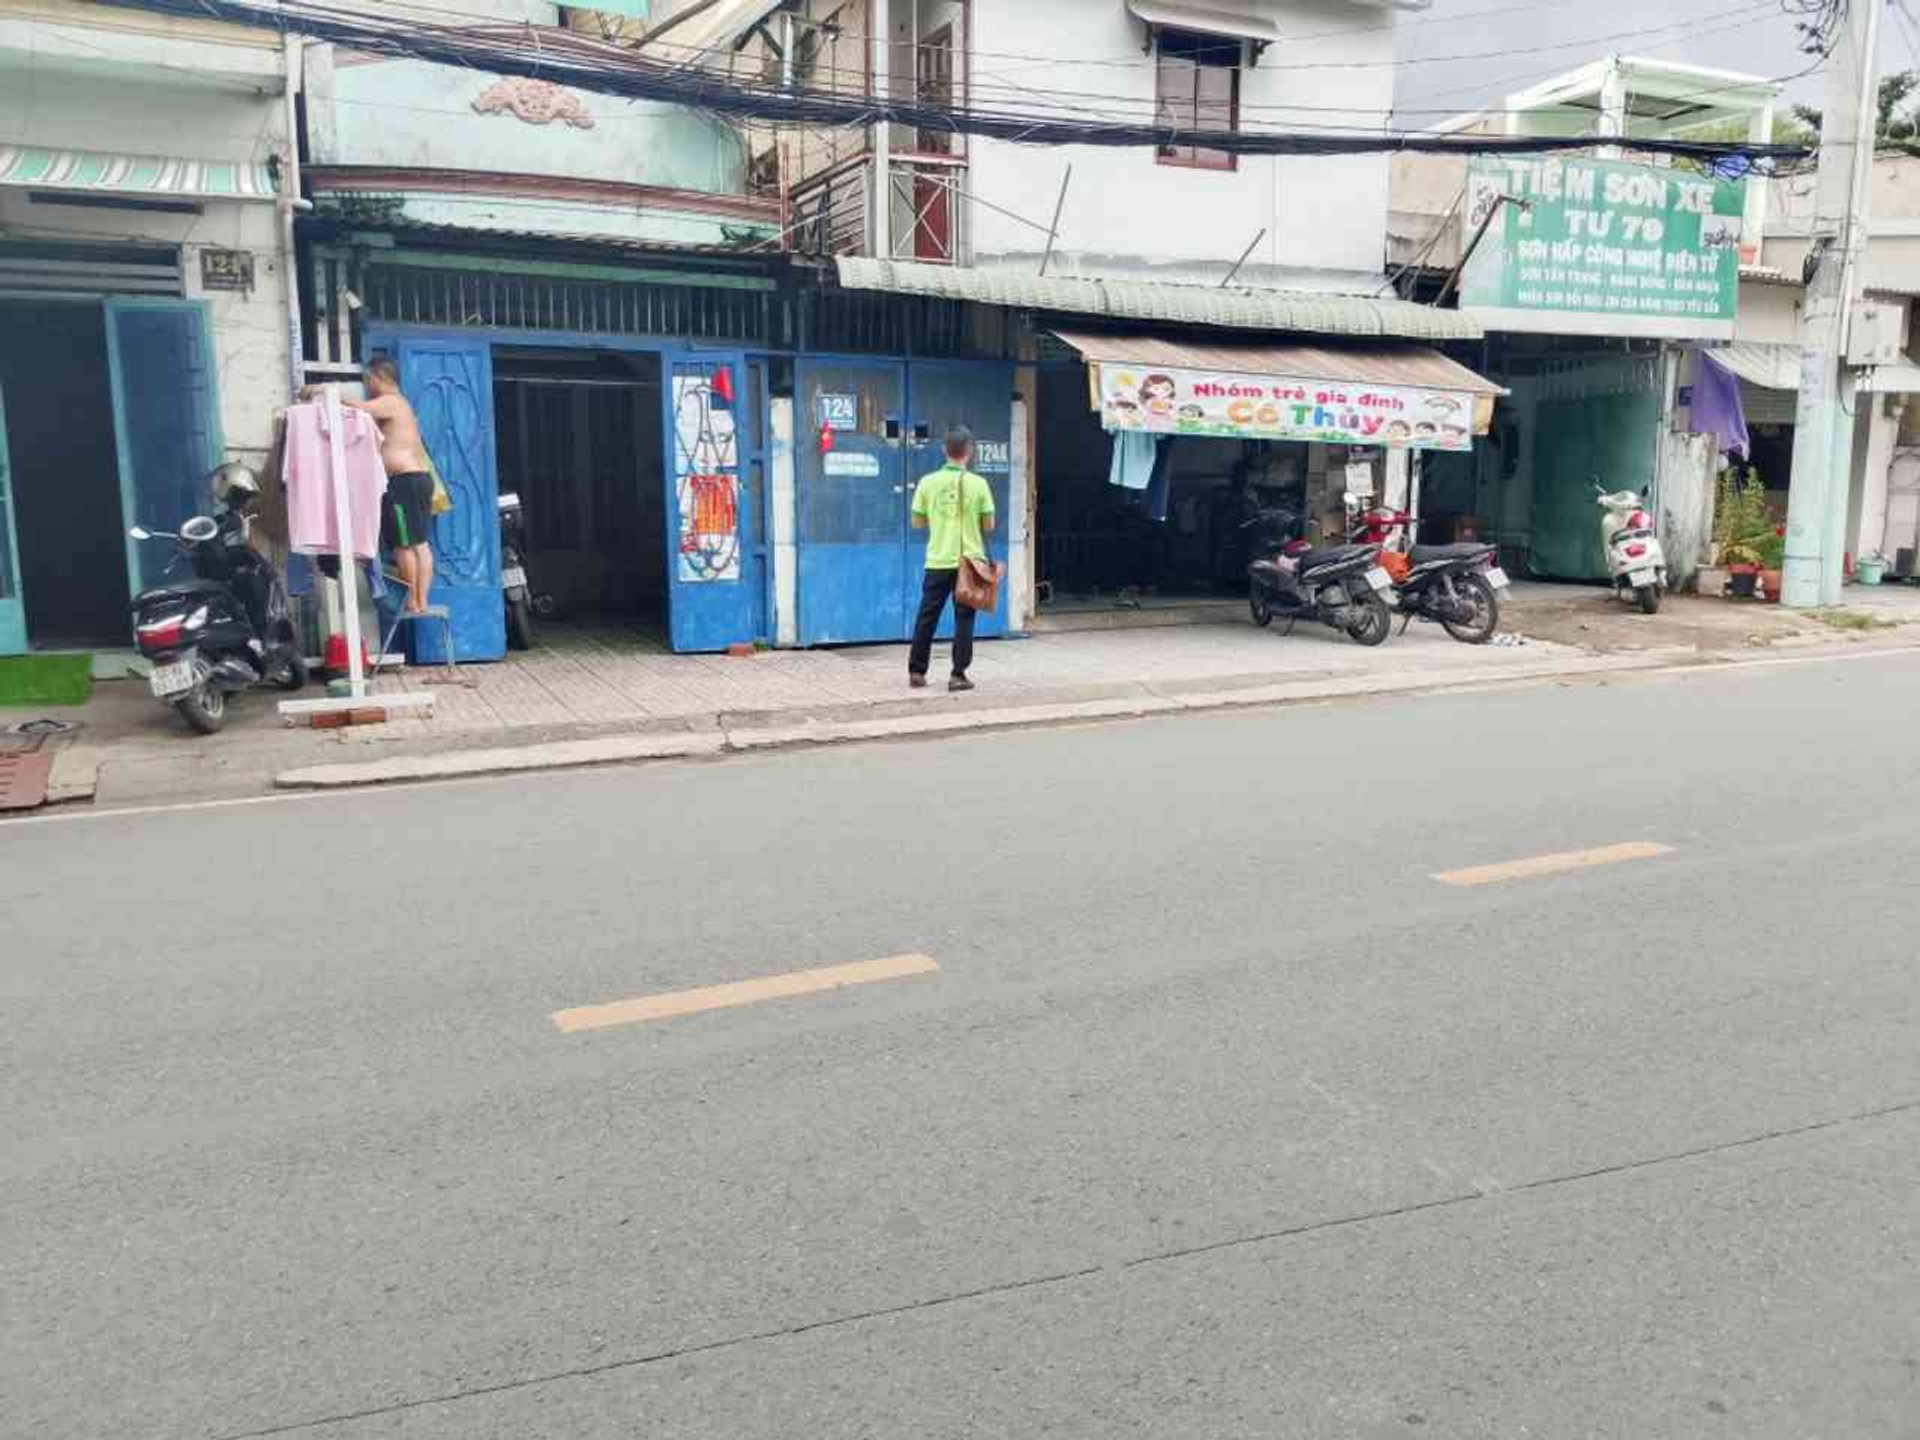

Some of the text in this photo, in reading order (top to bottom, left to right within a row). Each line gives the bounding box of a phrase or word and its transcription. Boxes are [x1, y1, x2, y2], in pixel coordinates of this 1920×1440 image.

[1505, 157, 1715, 214] TIỆM SƠN XE
[1565, 208, 1614, 236] TƯ
[1192, 383, 1263, 398] Nhóm
[1315, 389, 1347, 405] gia
[822, 398, 853, 417] 124
